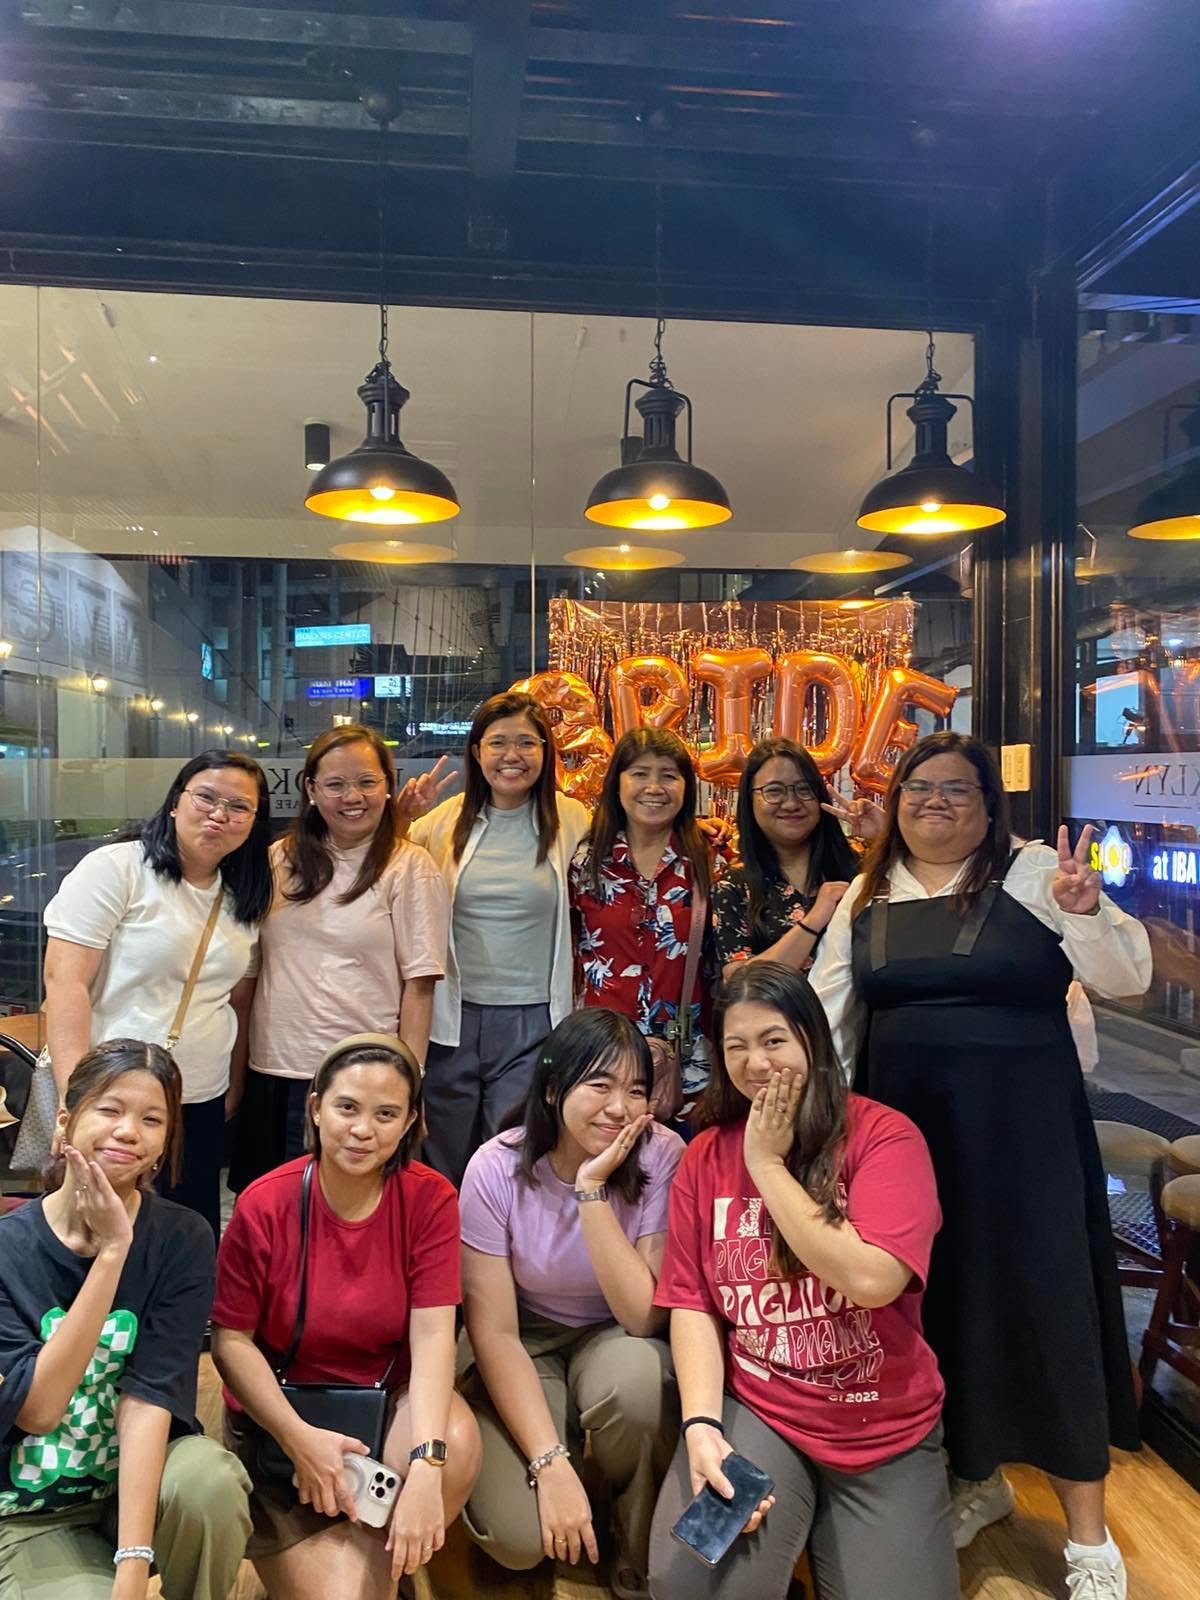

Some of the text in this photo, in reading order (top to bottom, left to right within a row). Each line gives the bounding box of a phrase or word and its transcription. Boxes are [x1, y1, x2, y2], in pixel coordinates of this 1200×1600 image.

[508, 648, 958, 796] BRIDE
[1152, 851, 1169, 881] at
[718, 1276, 856, 1326] PAGLILO
[845, 1390, 879, 1403] 2022
